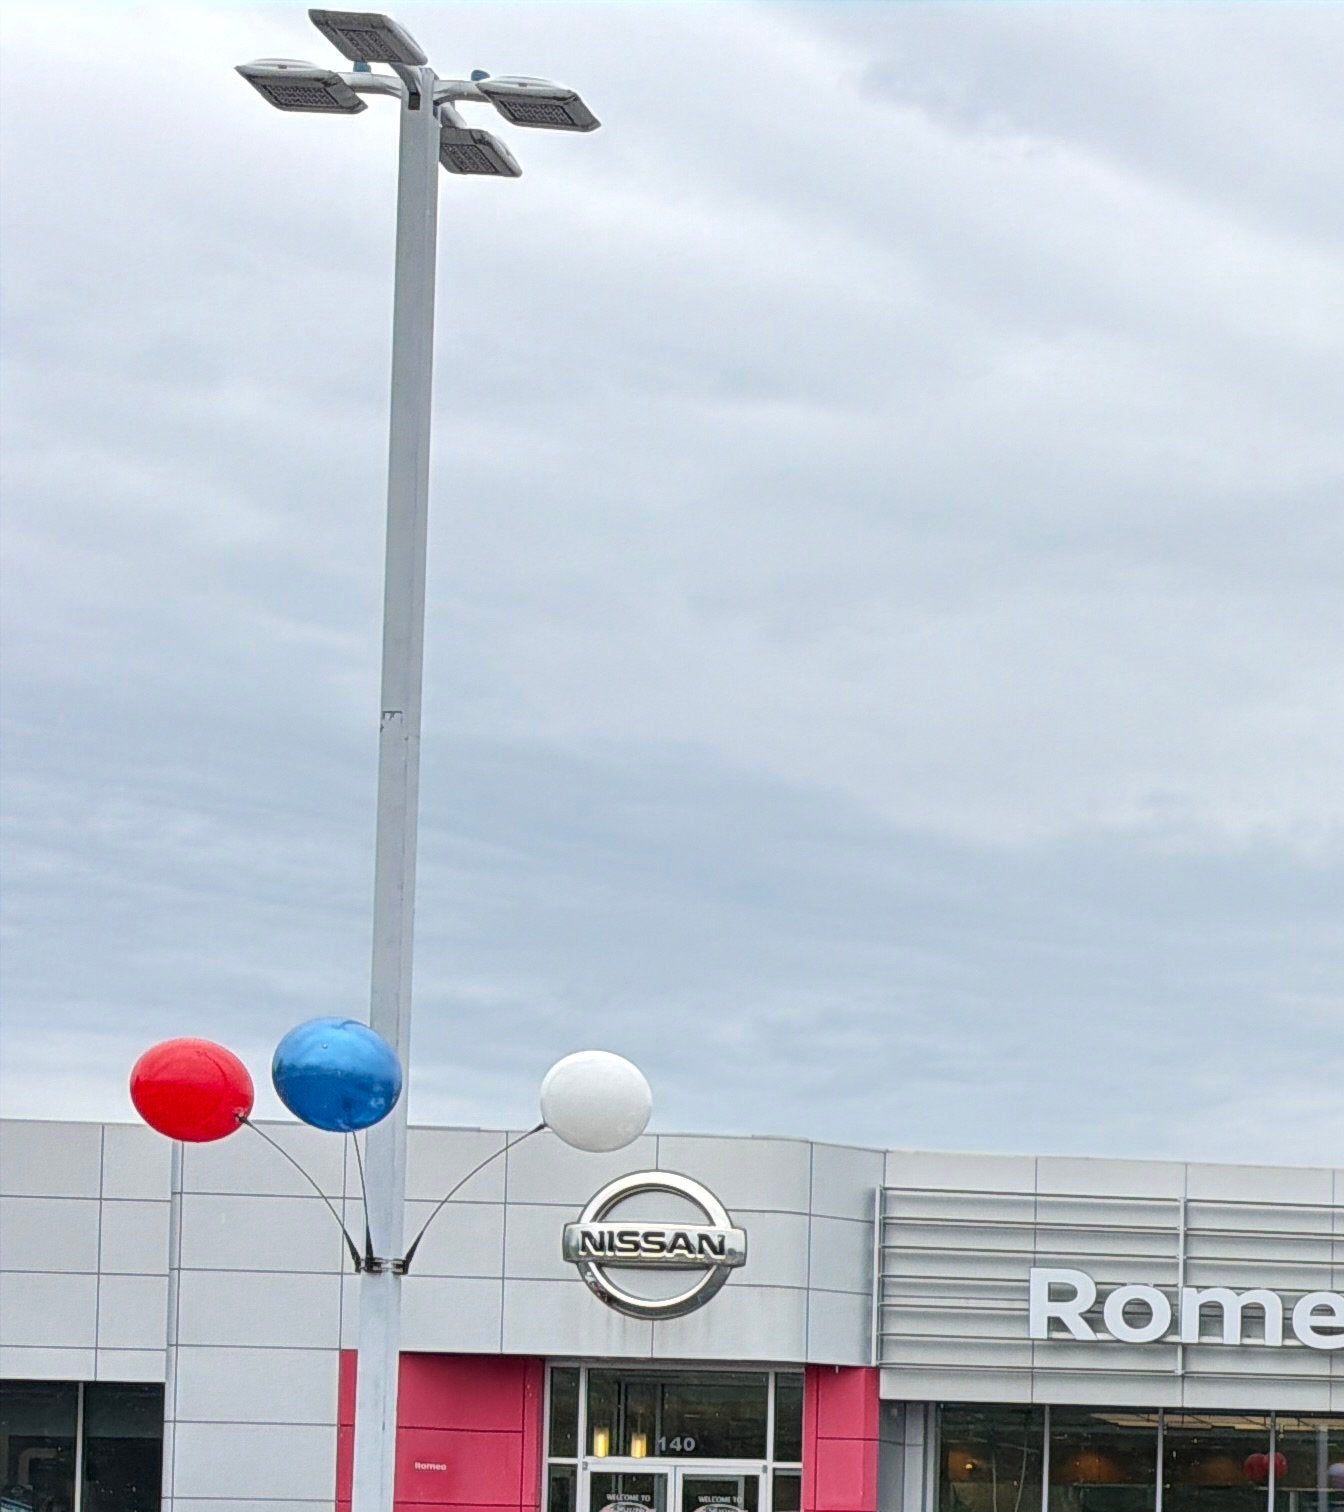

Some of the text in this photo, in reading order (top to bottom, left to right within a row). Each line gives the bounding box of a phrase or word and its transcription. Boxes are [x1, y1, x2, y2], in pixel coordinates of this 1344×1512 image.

[580, 1230, 726, 1259] NISSAN
[658, 1436, 696, 1451] 140
[414, 1461, 447, 1471] Romeo
